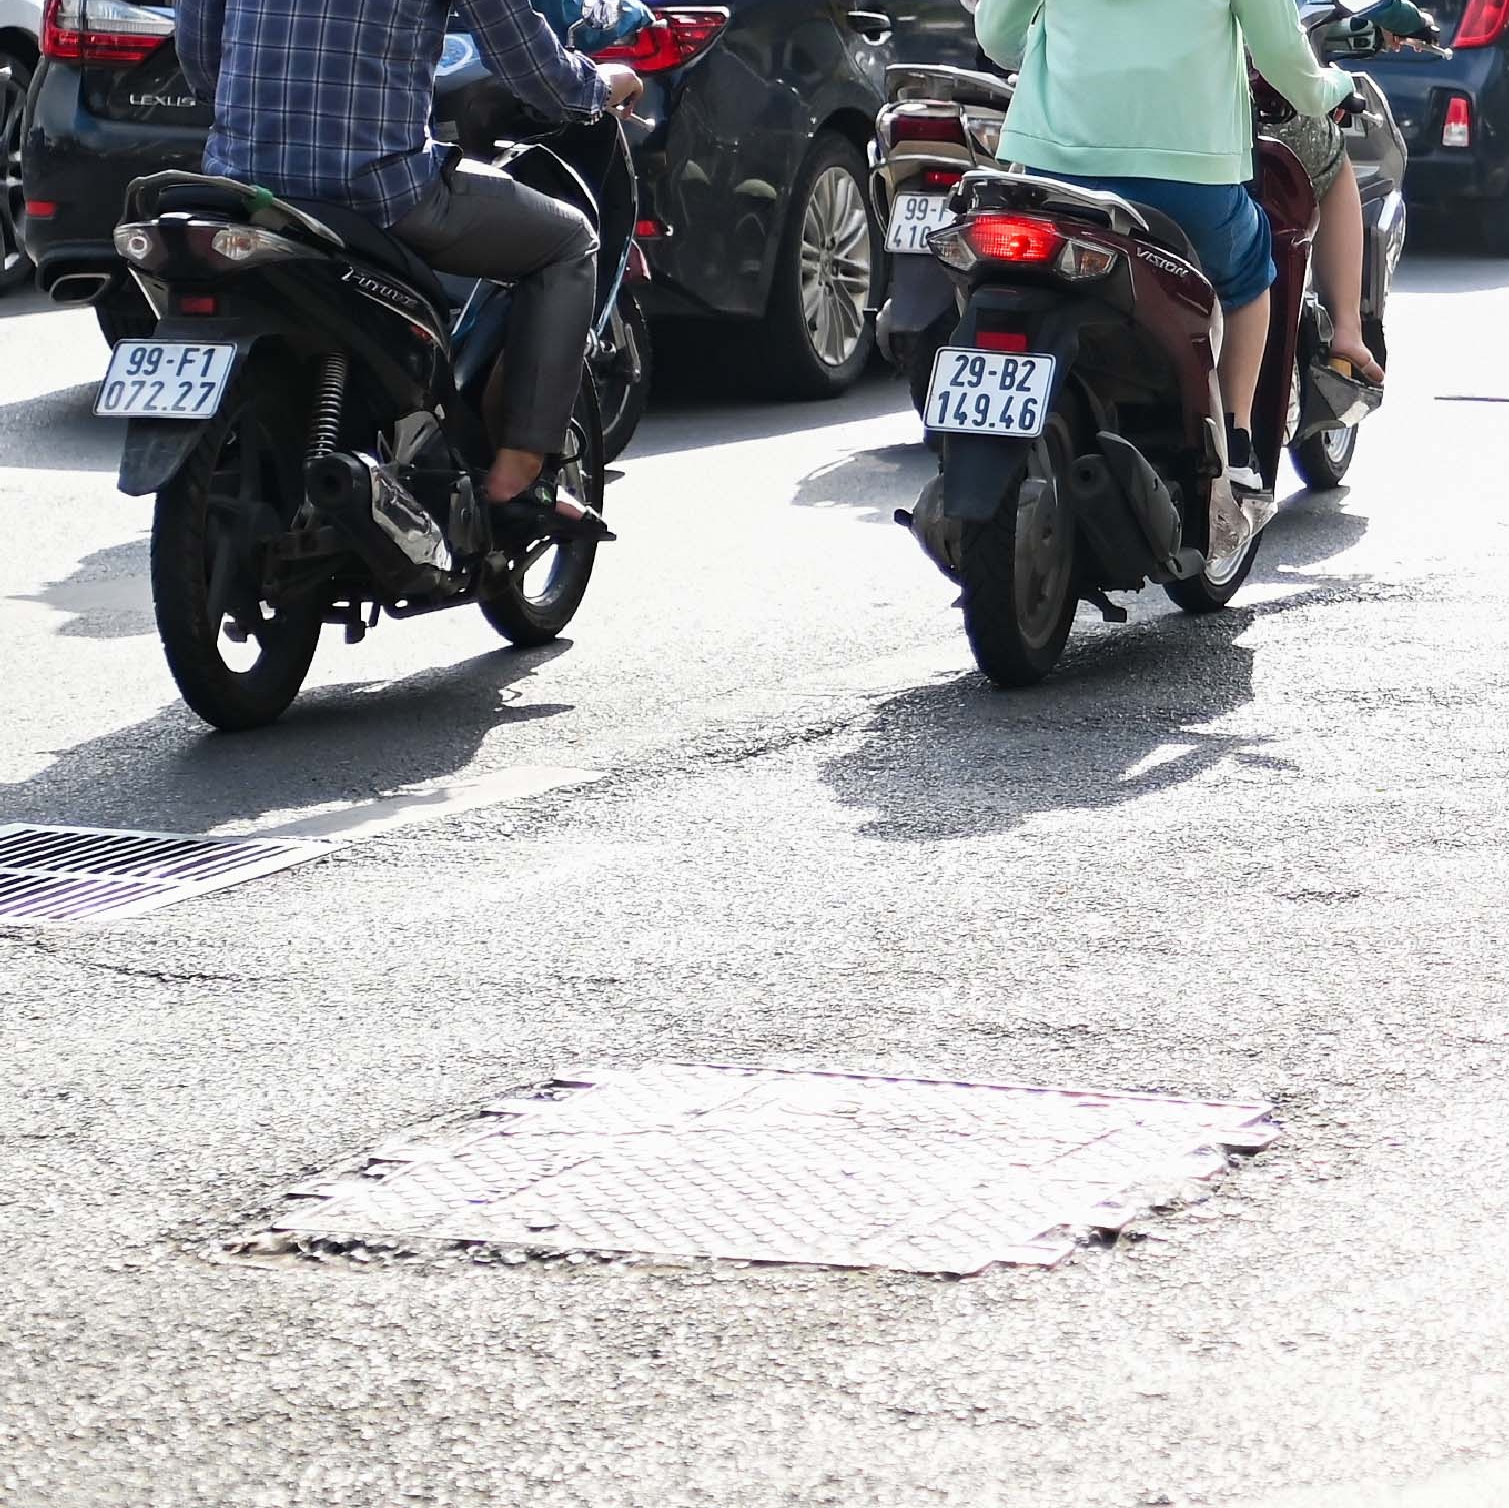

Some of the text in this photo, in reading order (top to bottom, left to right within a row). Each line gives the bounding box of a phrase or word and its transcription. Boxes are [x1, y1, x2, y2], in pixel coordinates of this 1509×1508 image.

[129, 94, 196, 107] LEXUS
[126, 347, 216, 378] 99-F1
[949, 354, 1036, 393] 29-B2
[104, 380, 217, 412] 072.27
[938, 390, 1039, 431] 149.46
